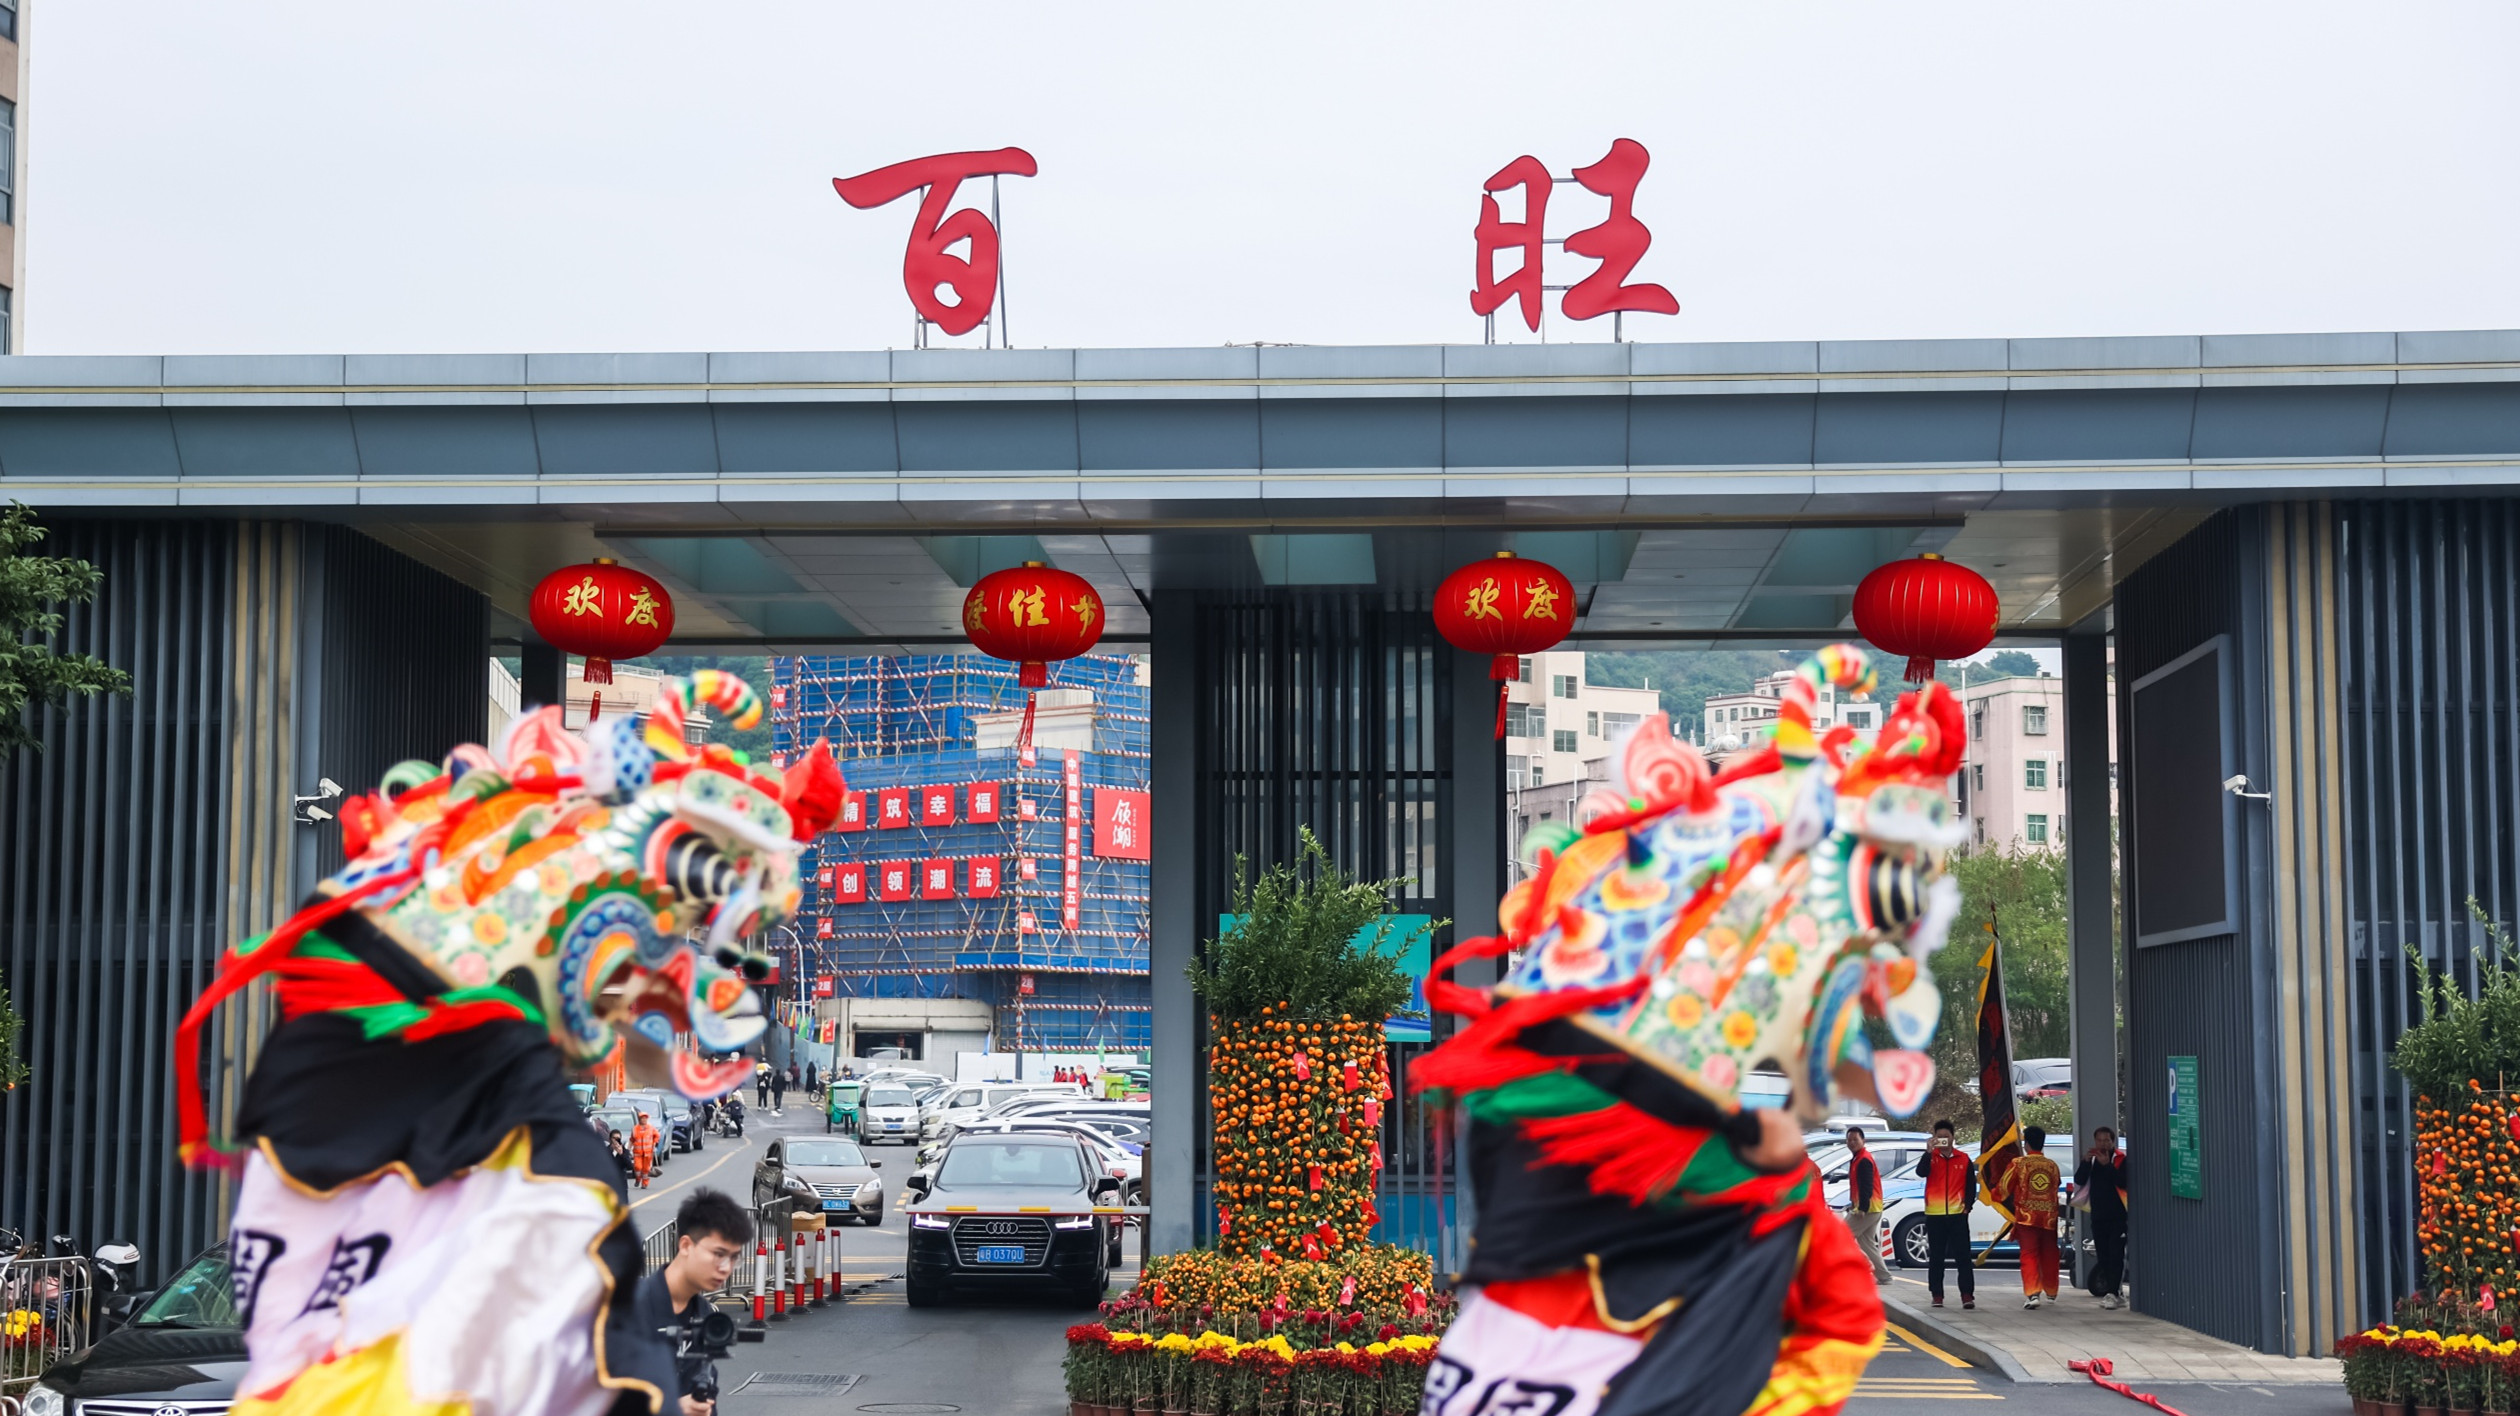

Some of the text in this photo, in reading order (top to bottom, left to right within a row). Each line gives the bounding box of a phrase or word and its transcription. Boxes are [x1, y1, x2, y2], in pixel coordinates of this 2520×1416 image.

[832, 138, 1680, 335] 百旺
[563, 576, 660, 631] 欢度
[1463, 577, 1559, 622] 欢度
[844, 792, 992, 822] 精筑幸福
[842, 866, 992, 893] 创领潮流
[2169, 1067, 2176, 1109] P
